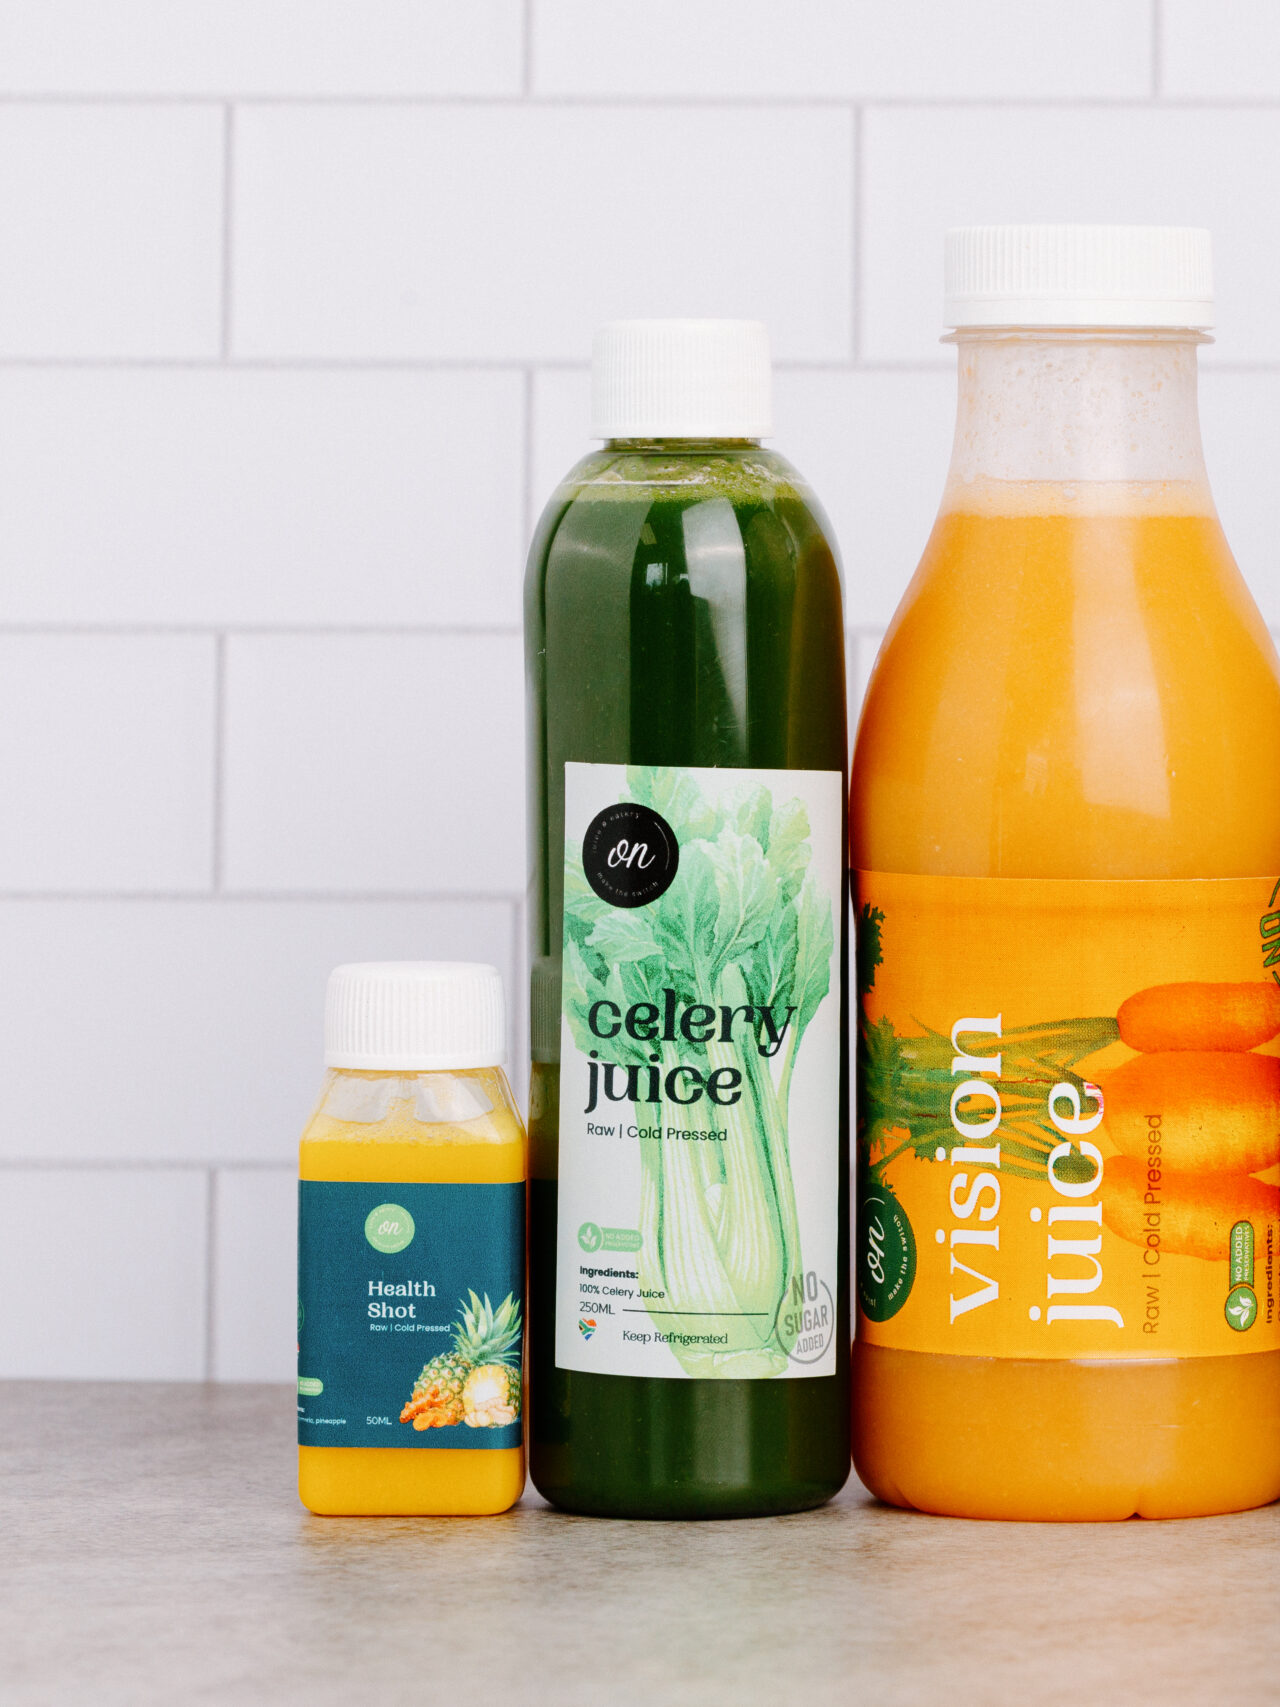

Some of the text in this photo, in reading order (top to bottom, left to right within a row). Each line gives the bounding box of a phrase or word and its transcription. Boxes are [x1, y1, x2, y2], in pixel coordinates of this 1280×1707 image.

[607, 839, 656, 869] on
[588, 988, 797, 1057] celery
[584, 1050, 742, 1114] juice
[587, 1123, 615, 1137] Raw
[627, 1125, 662, 1140] Cold
[667, 1127, 728, 1141] Pressed
[935, 1012, 1002, 1325] vision
[1144, 1114, 1162, 1203] Pressed
[1029, 1081, 1125, 1329] juice
[378, 1220, 402, 1235] on
[1143, 1211, 1161, 1265] Cold
[868, 1216, 885, 1284] on
[1235, 1226, 1243, 1282] NO ADDED
[580, 1265, 639, 1279] Ingredients:
[1265, 1224, 1275, 1324] Ingredients:
[368, 1280, 437, 1297] Health
[579, 1283, 665, 1300] 100% Celery Juice
[792, 1271, 818, 1306] NO
[367, 1301, 416, 1318] Shot
[580, 1301, 615, 1315] 250ML
[784, 1304, 828, 1336] SUGAR
[1143, 1286, 1159, 1334] Raw
[370, 1324, 388, 1332] Raw
[395, 1324, 415, 1332] Cold
[416, 1324, 450, 1332] Pressed
[622, 1331, 728, 1345] Keep Refrigerated
[797, 1333, 824, 1354] ADDED
[366, 1416, 392, 1425] 50ML
